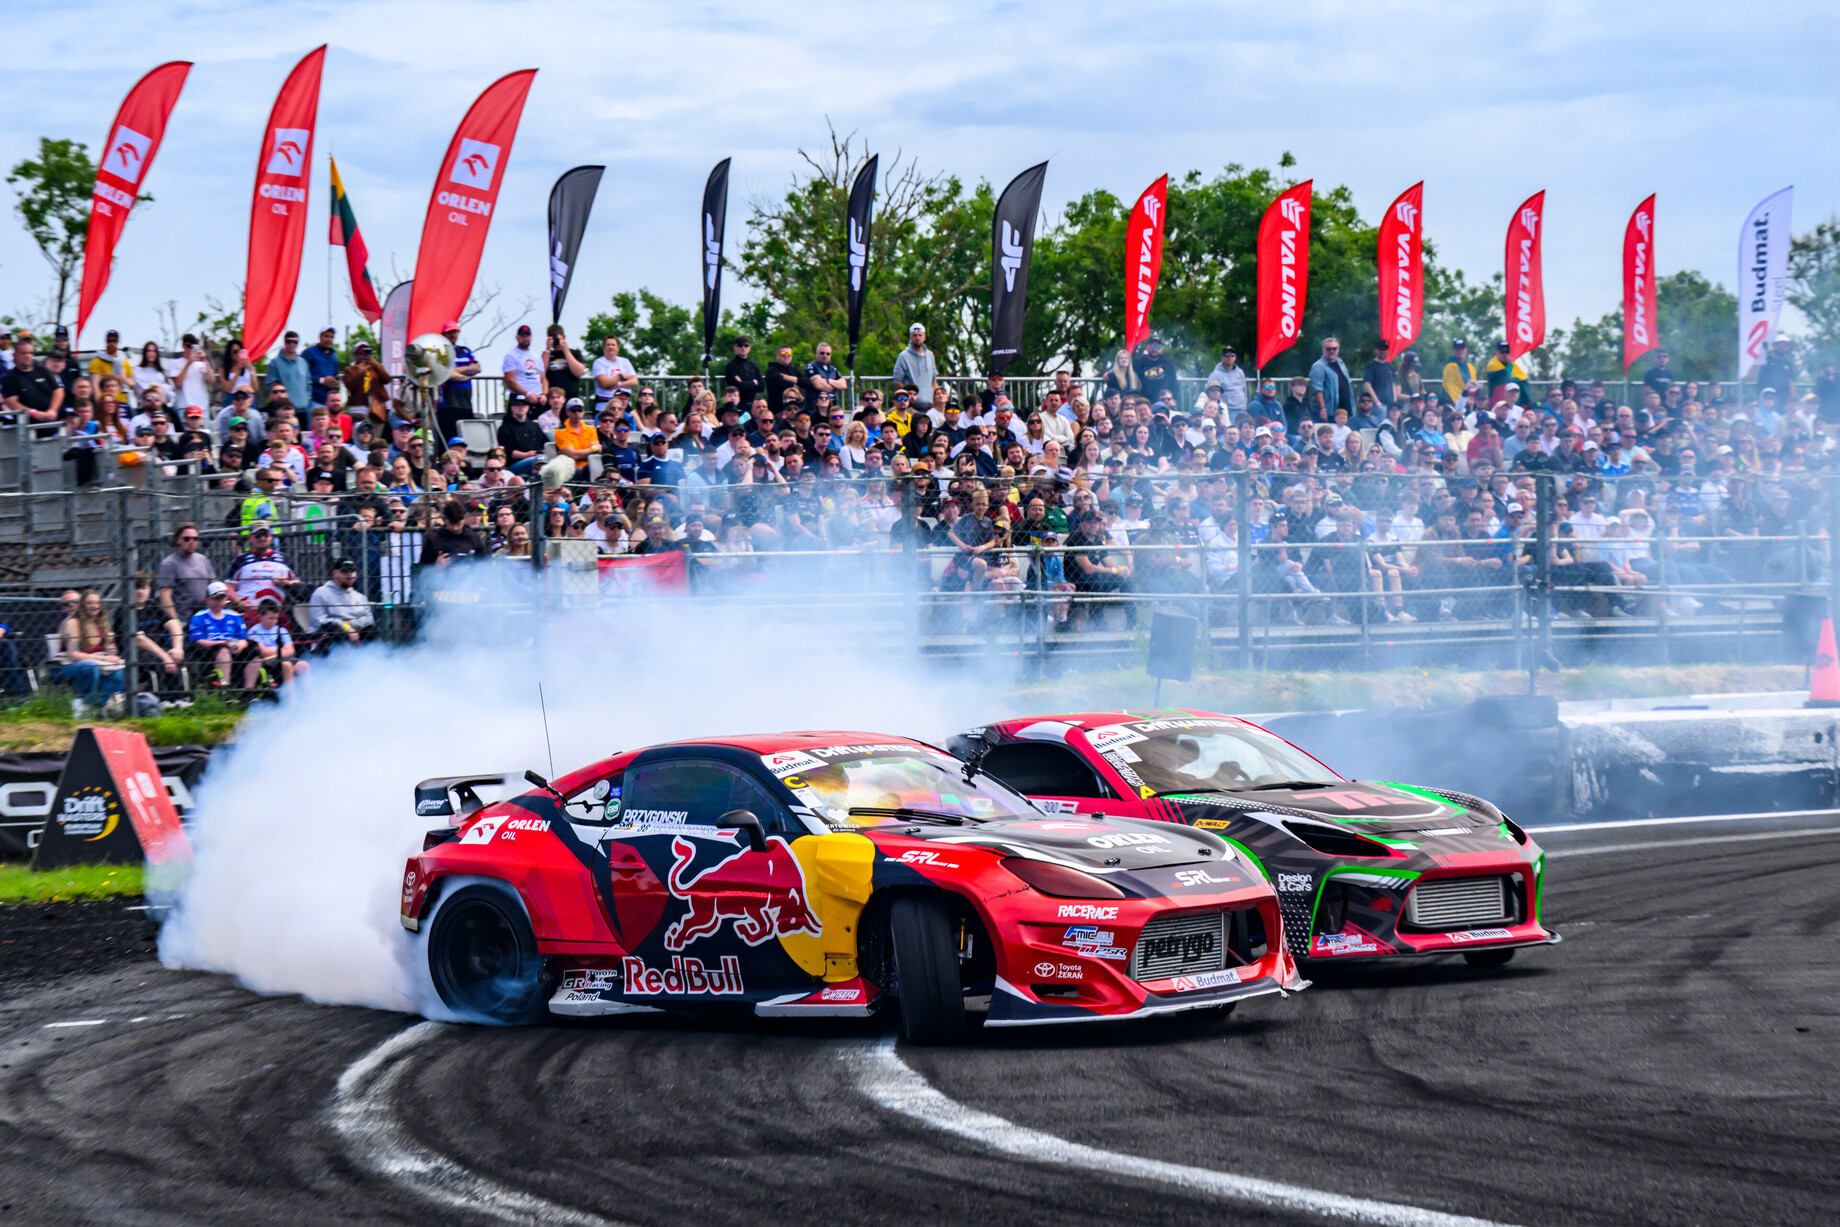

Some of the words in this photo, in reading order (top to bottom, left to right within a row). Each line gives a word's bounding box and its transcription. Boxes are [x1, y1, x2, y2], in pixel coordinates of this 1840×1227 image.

[93, 180, 135, 209] ORLEN
[259, 184, 306, 202] ORLEN
[96, 202, 113, 217] OIL
[271, 203, 289, 216] OIL
[437, 191, 492, 217] ORLEN
[448, 212, 469, 226] OIL
[1751, 211, 1770, 313] Budmat.
[1137, 228, 1154, 327] VALIN
[1281, 231, 1296, 338] VALINO
[1396, 233, 1412, 340] VALINO
[1516, 239, 1533, 344] VALINO
[1633, 243, 1649, 345] VALINO
[771, 759, 819, 774] Budmat.
[784, 776, 806, 788] C
[1139, 785, 1157, 800] A
[622, 809, 688, 825] PRZYGONSKI
[508, 819, 551, 832] ORLEN
[501, 831, 516, 840] OIL
[1086, 833, 1173, 849] ORLEN
[1135, 845, 1173, 854] OIL
[901, 850, 940, 866] SRL
[1175, 869, 1221, 887] SRL
[1278, 873, 1312, 885] Design
[1142, 932, 1214, 968] petrygo
[1059, 963, 1081, 971] Toyota
[563, 977, 585, 989] GR
[586, 982, 612, 990] Racing
[1196, 971, 1239, 987] Budmat.
[565, 991, 600, 1002] Poland
